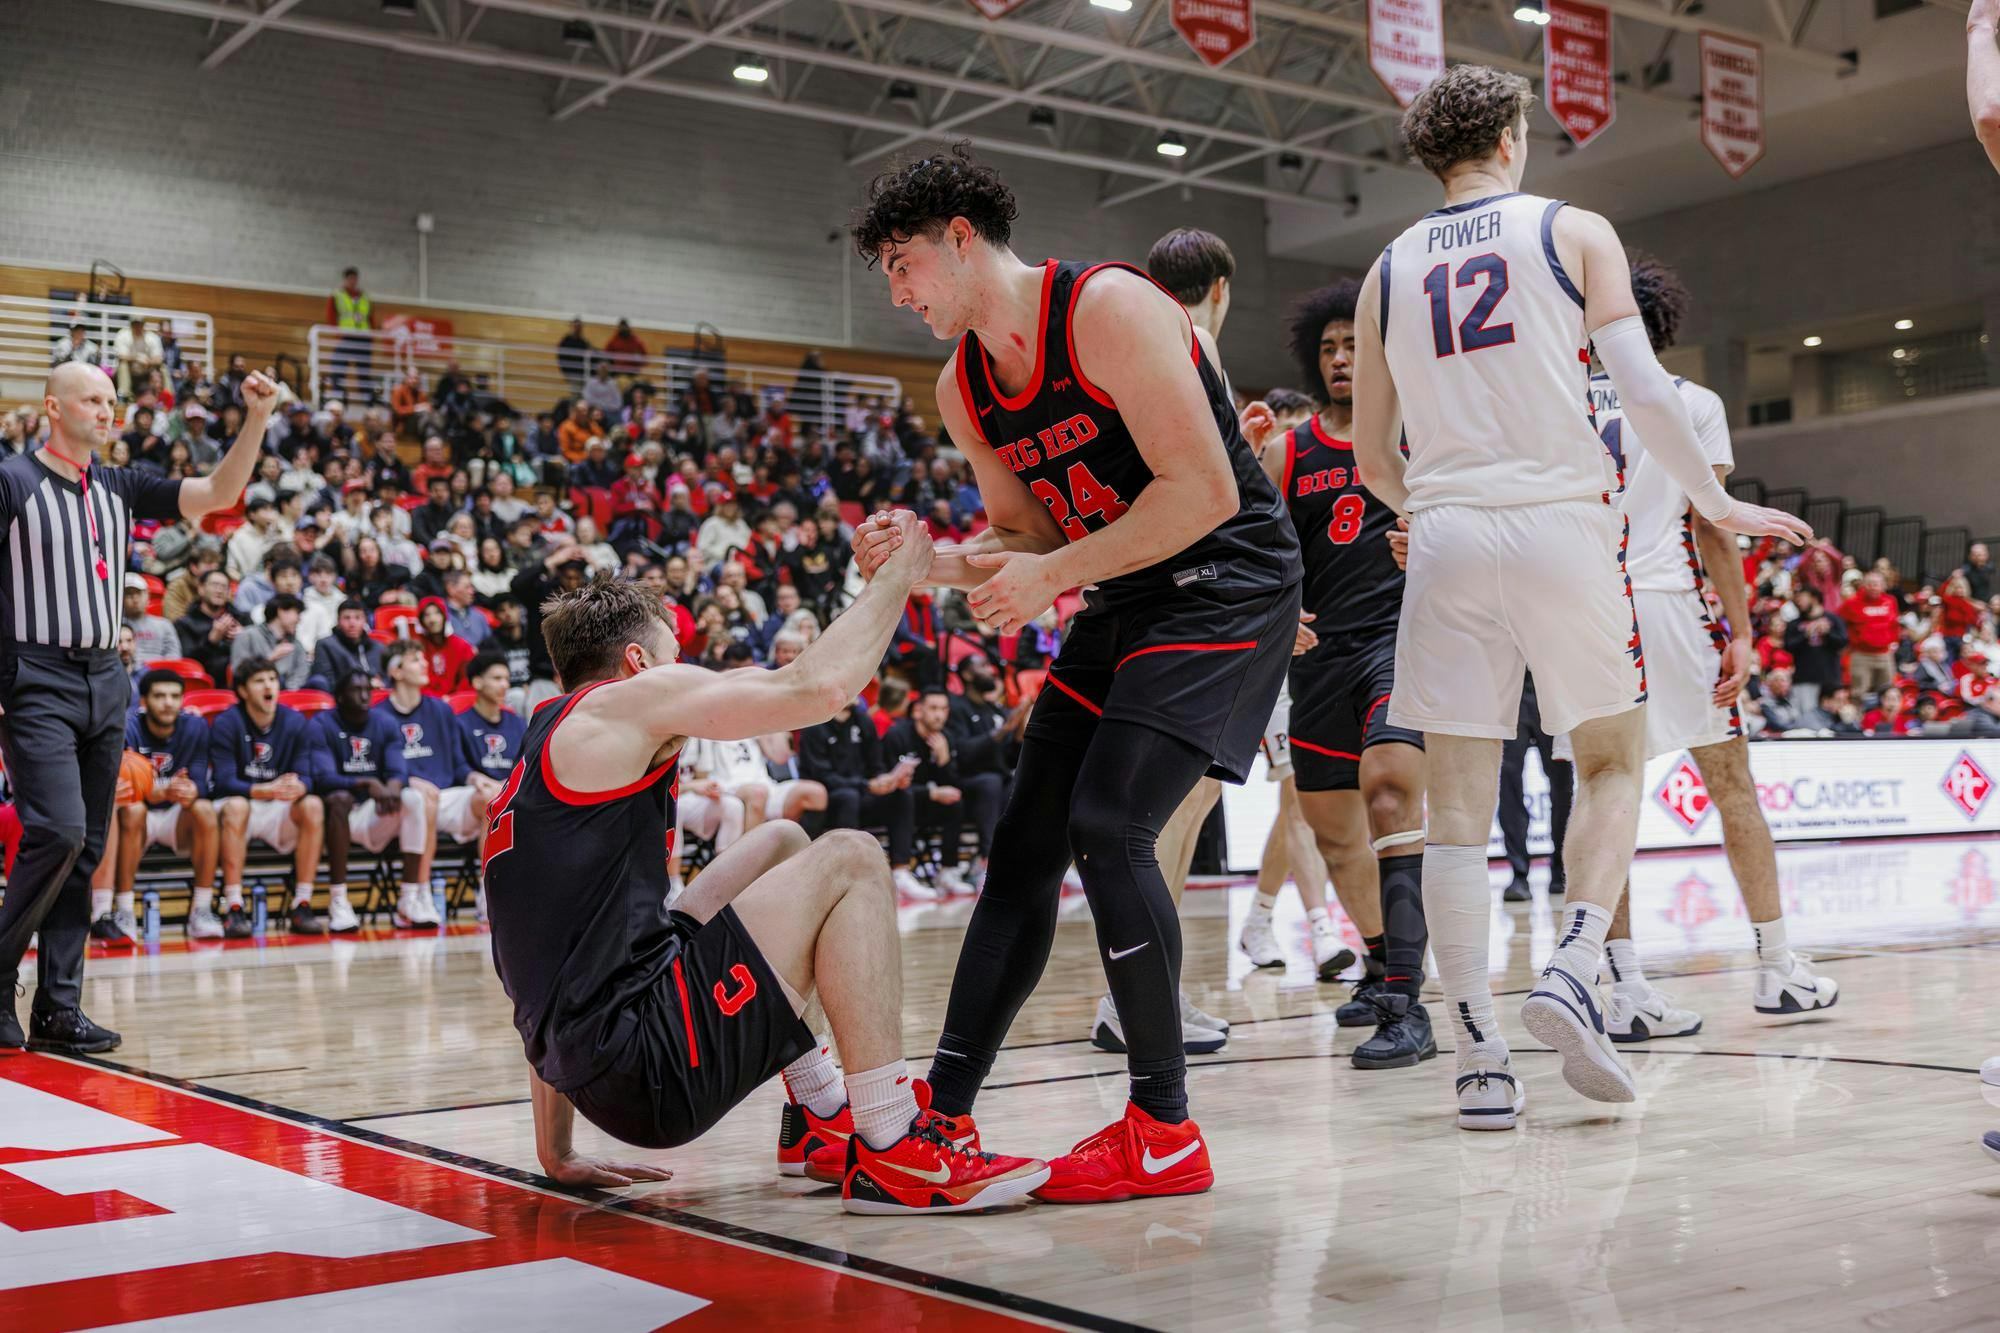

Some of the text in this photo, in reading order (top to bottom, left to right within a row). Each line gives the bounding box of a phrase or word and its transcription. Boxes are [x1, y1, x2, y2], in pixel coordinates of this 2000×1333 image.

[1427, 211, 1501, 253] POWER
[1423, 252, 1516, 359] 12
[993, 413, 1099, 473] BIG RED
[1029, 461, 1131, 541] 24
[1296, 467, 1348, 497] BIG
[1327, 494, 1366, 545] 8
[1200, 568, 1213, 576] XL
[1275, 732, 1288, 751] P
[1755, 779, 1904, 811] ROCARPET
[713, 963, 757, 1016] C
